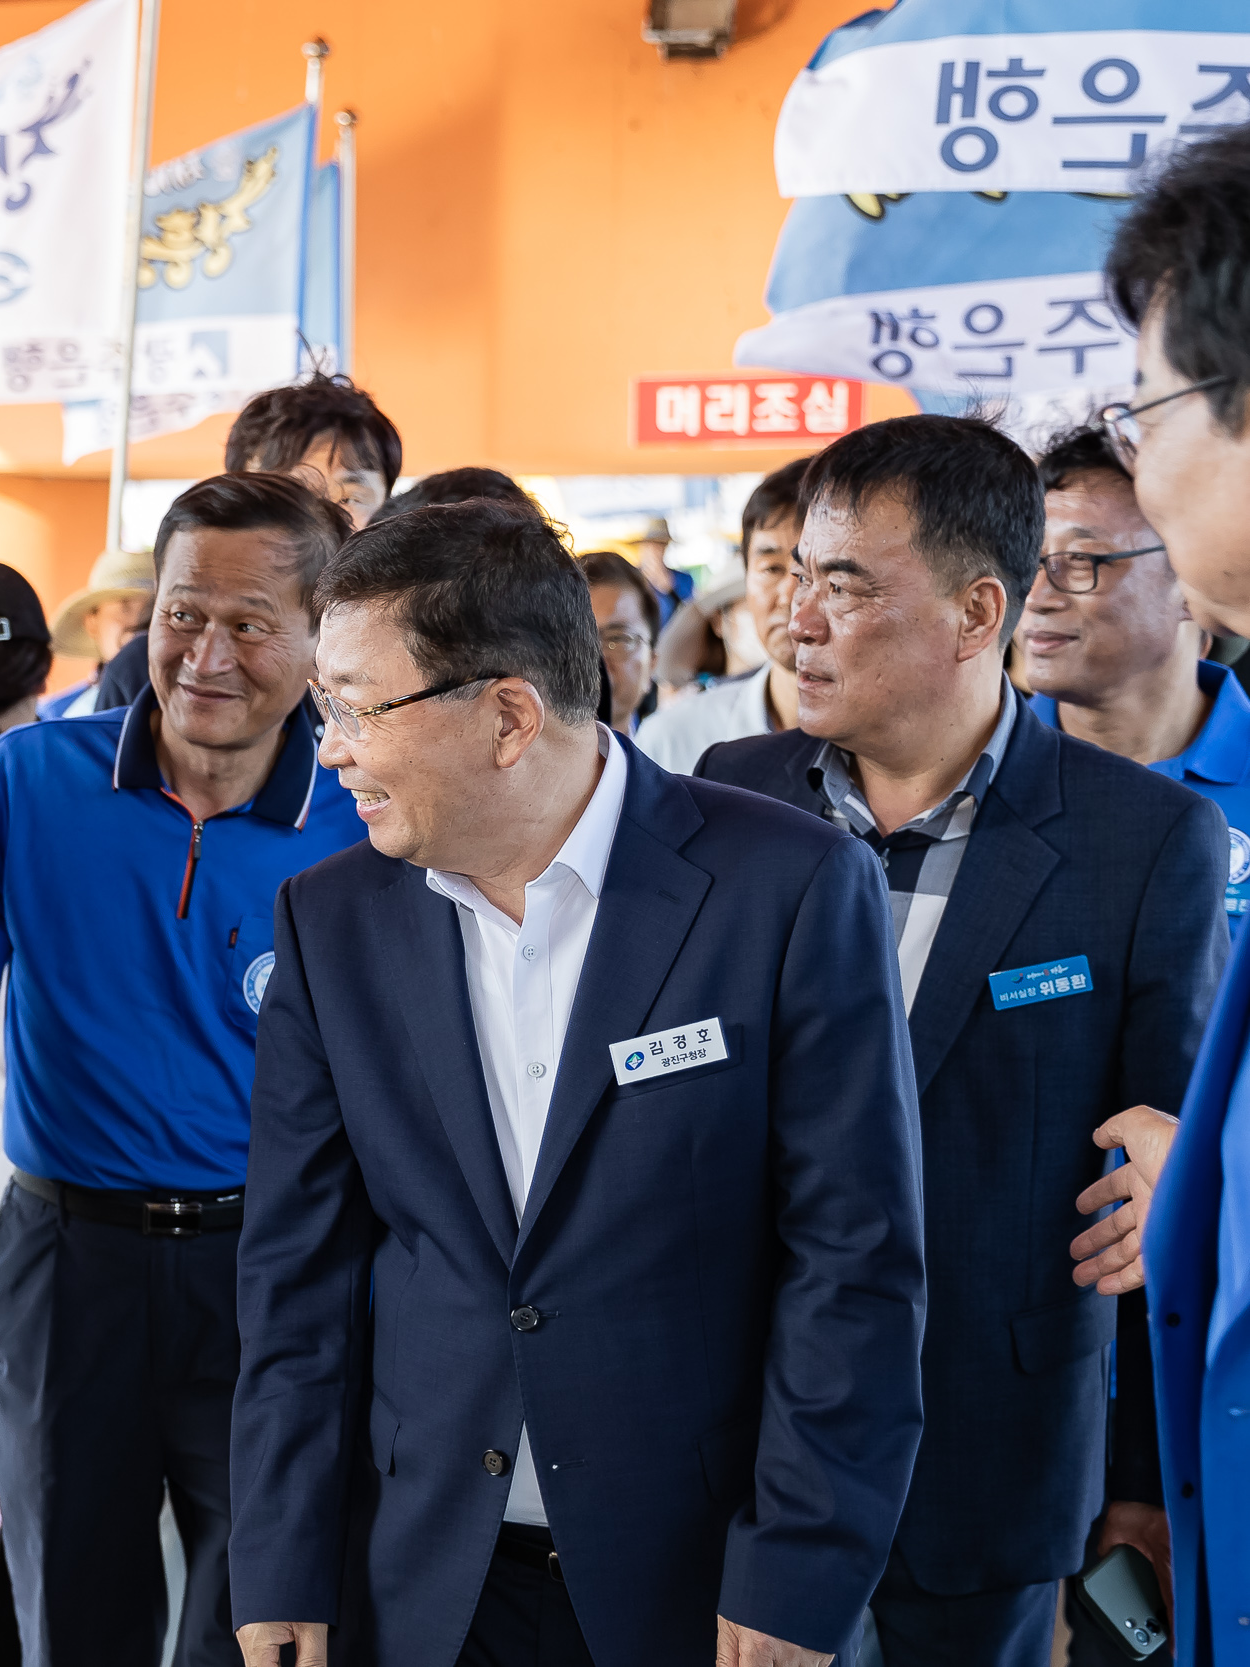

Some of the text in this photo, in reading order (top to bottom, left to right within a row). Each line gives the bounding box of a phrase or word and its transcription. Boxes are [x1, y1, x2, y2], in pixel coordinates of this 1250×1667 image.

[655, 381, 850, 437] 머리조심
[999, 987, 1037, 1002] 비서실장
[661, 1049, 707, 1067] 광진구청장
